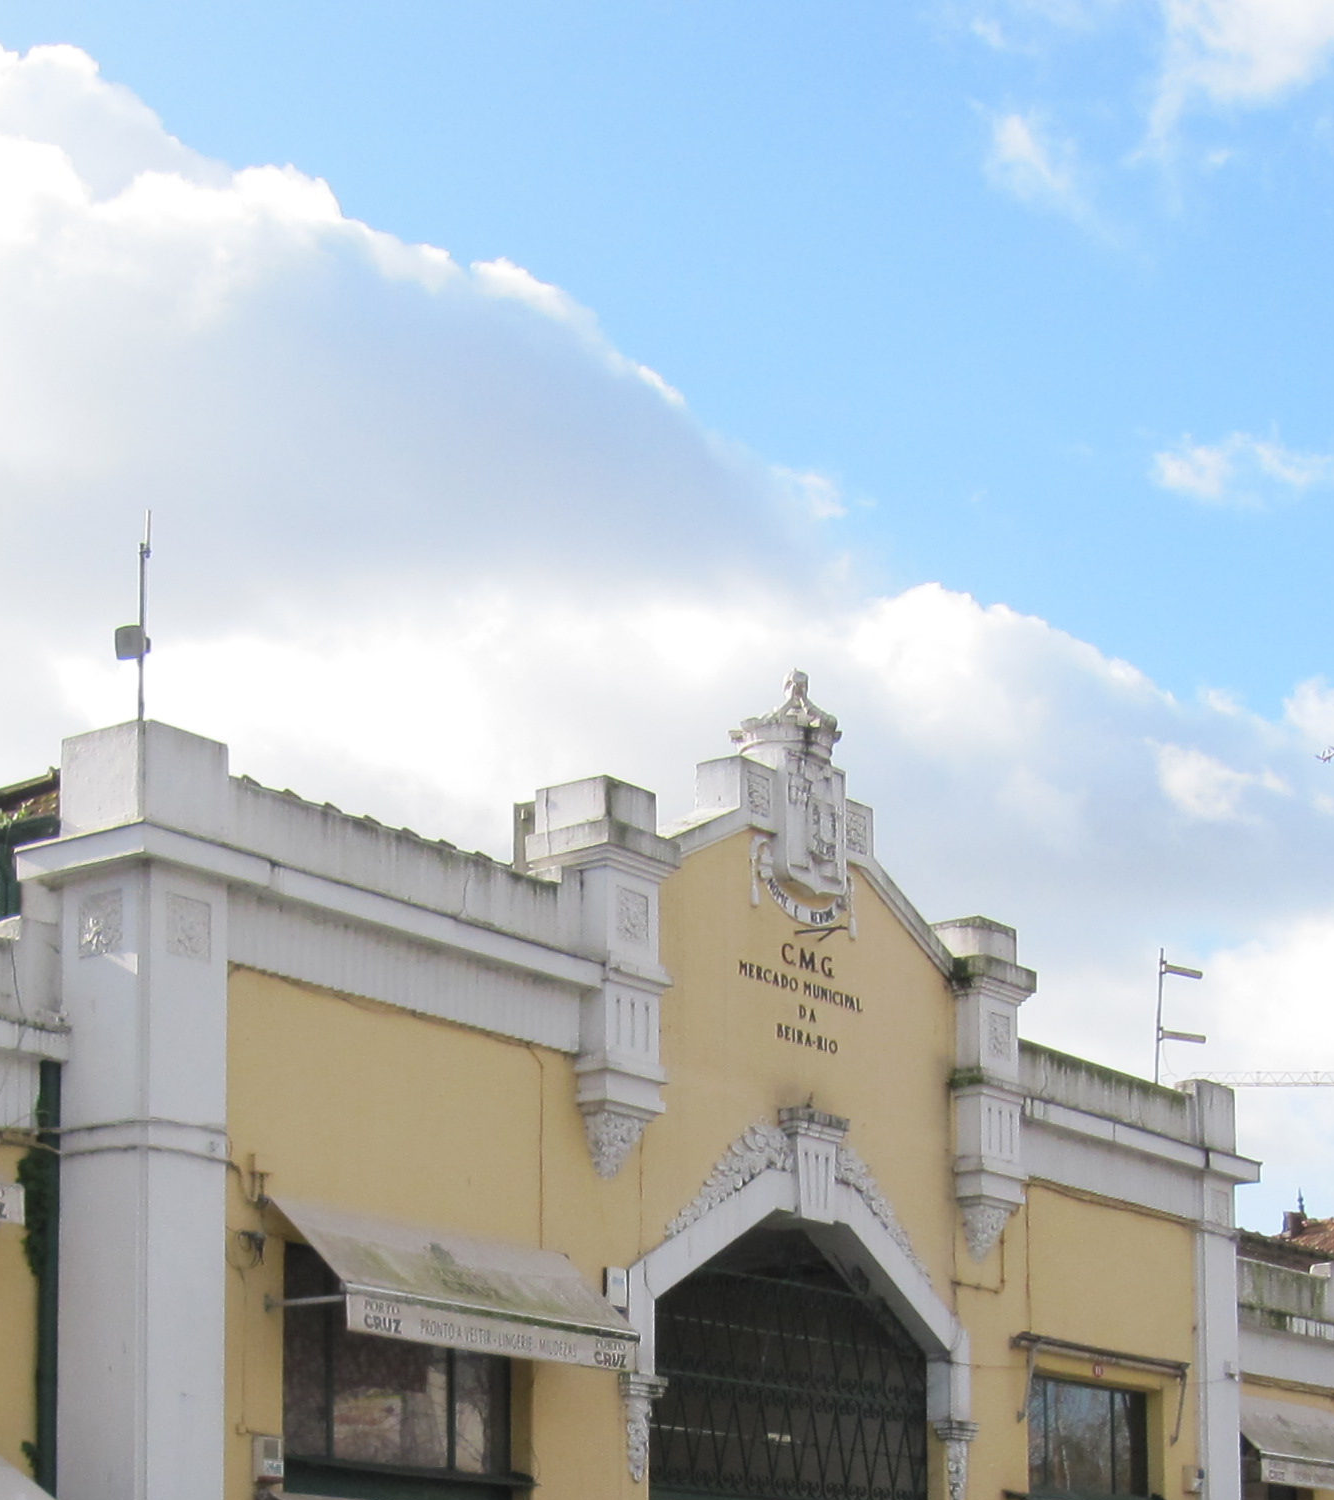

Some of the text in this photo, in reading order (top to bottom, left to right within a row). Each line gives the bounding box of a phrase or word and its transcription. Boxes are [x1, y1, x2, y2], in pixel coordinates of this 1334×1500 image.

[738, 959, 864, 1014] MERCADO MUNICIPAL
[798, 1004, 817, 1023] DA
[776, 1022, 839, 1055] BEIRA-RIO
[364, 1299, 400, 1315] PORTO
[363, 1313, 403, 1334] CRUZ
[594, 1336, 627, 1350] PORTO
[593, 1351, 628, 1369] CRUZ
